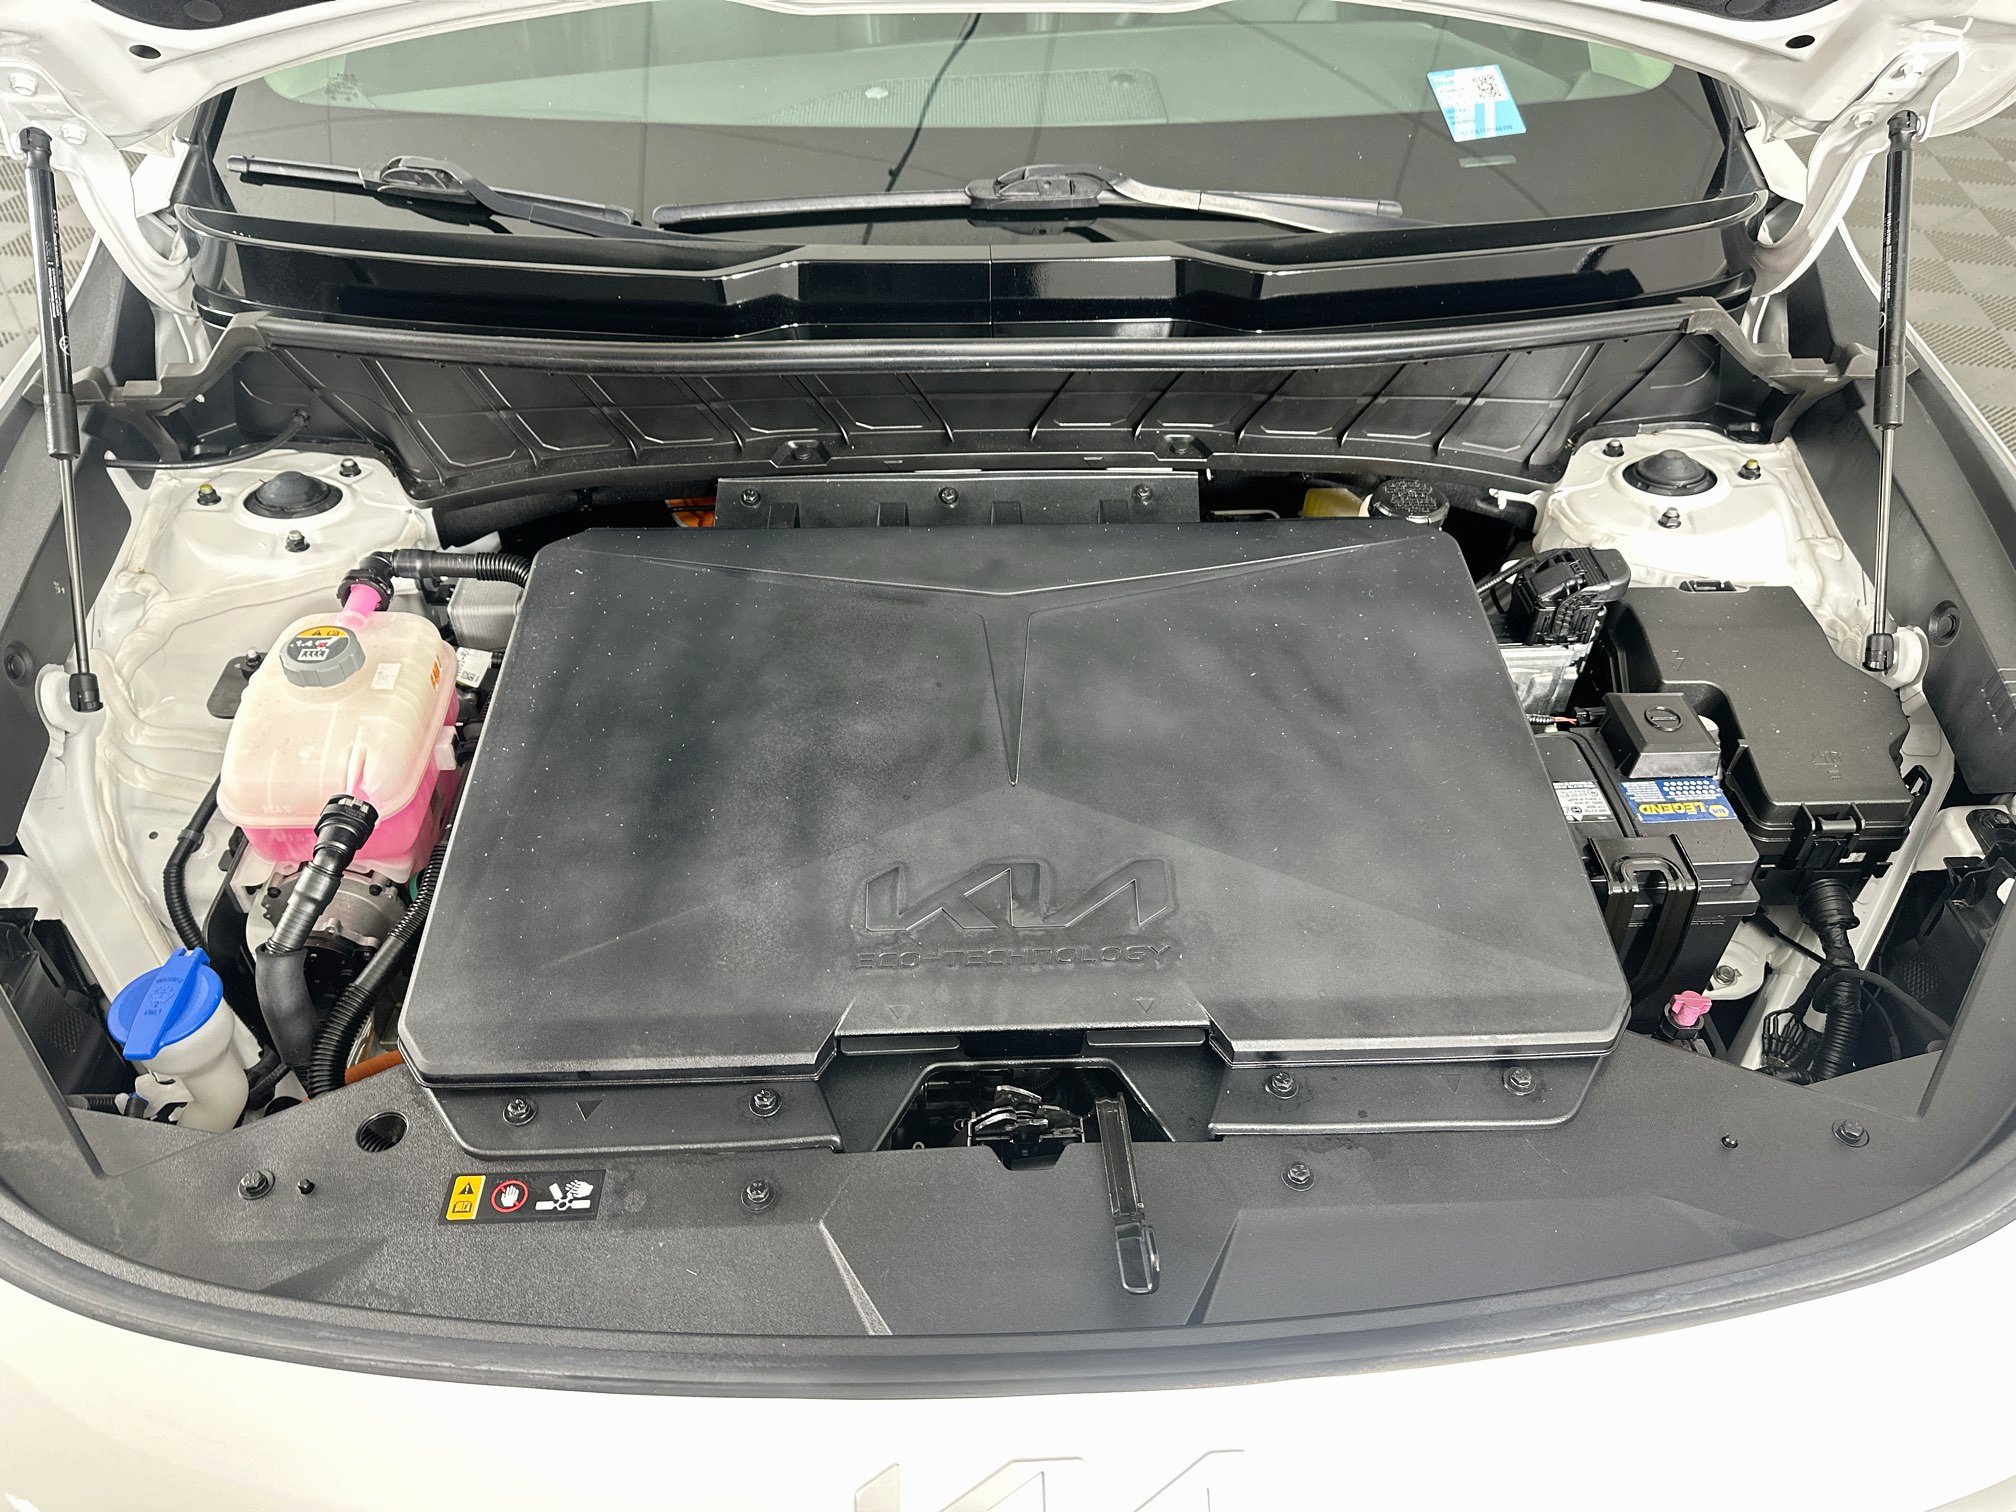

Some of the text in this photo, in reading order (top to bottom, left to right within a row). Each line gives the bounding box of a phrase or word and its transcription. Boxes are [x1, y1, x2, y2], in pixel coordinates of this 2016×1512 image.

[1639, 801, 1707, 815] LEGEND
[863, 857, 1171, 931] KIA
[856, 945, 1172, 968] ECO-TECHNOLOGY
